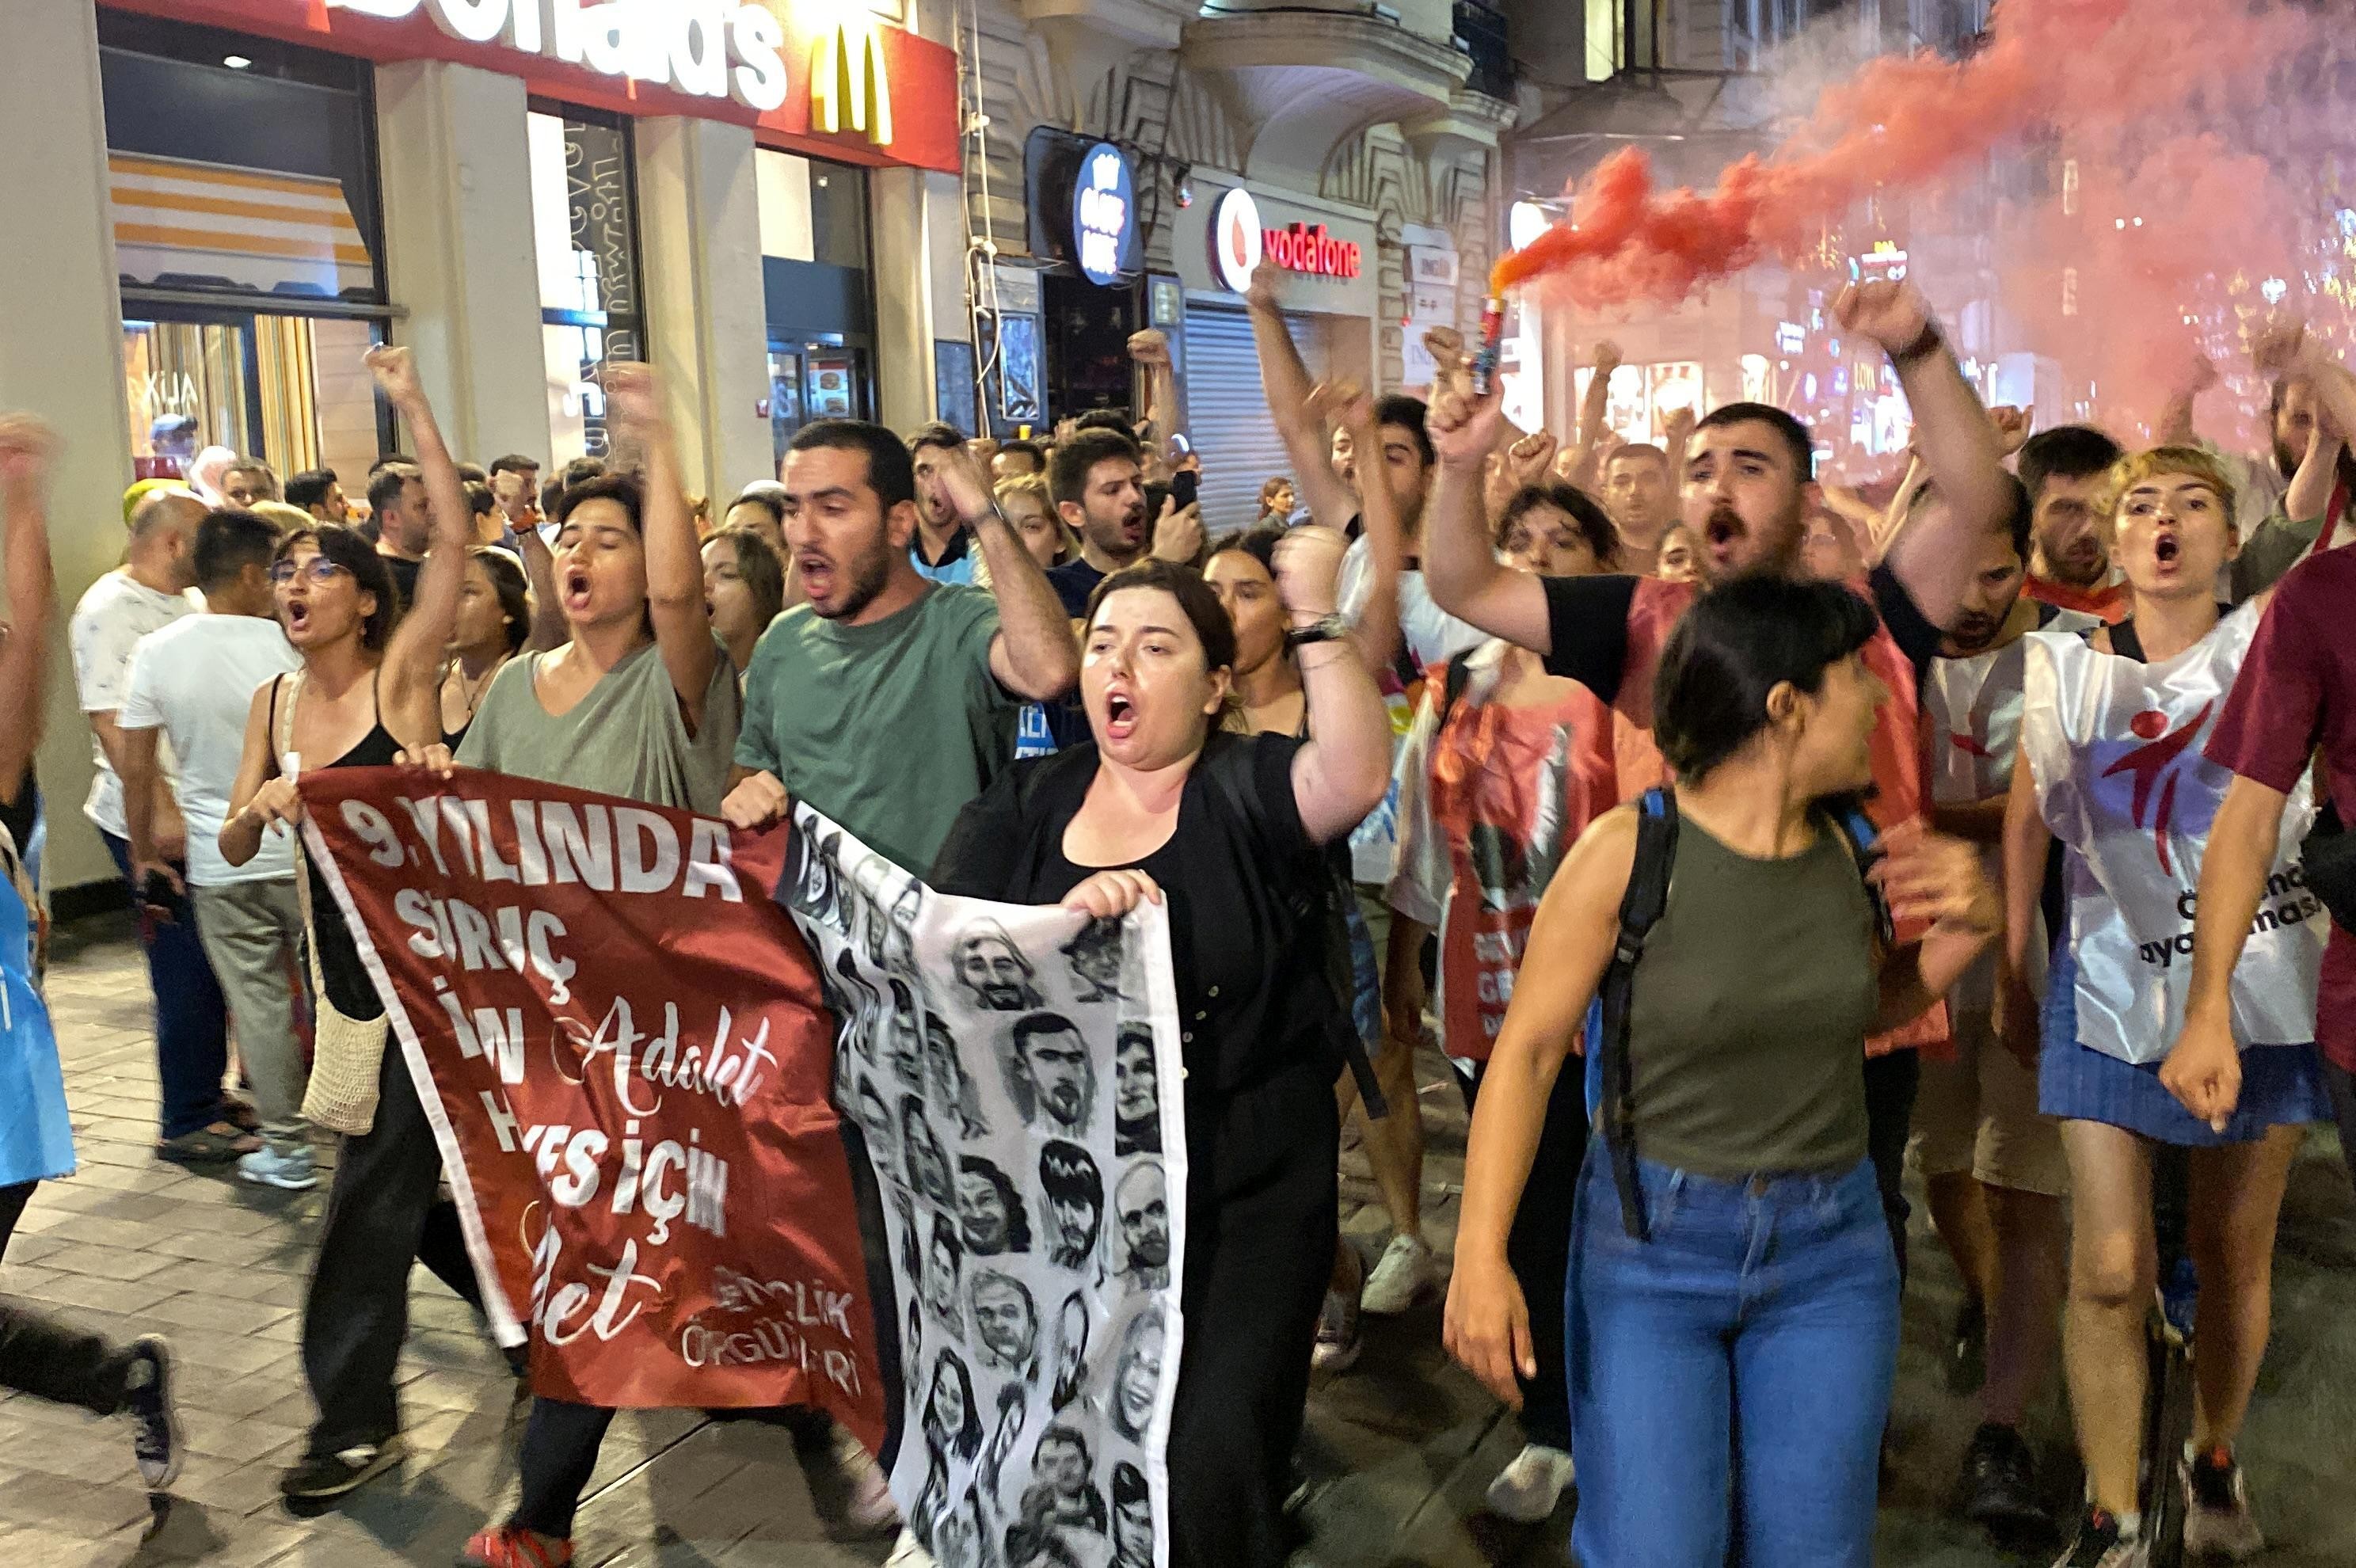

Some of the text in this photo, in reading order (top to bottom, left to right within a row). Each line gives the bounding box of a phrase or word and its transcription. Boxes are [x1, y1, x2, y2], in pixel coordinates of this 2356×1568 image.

[325, 0, 788, 111] onald's
[1263, 221, 1362, 279] vodafone
[551, 995, 778, 1117] Adalet
